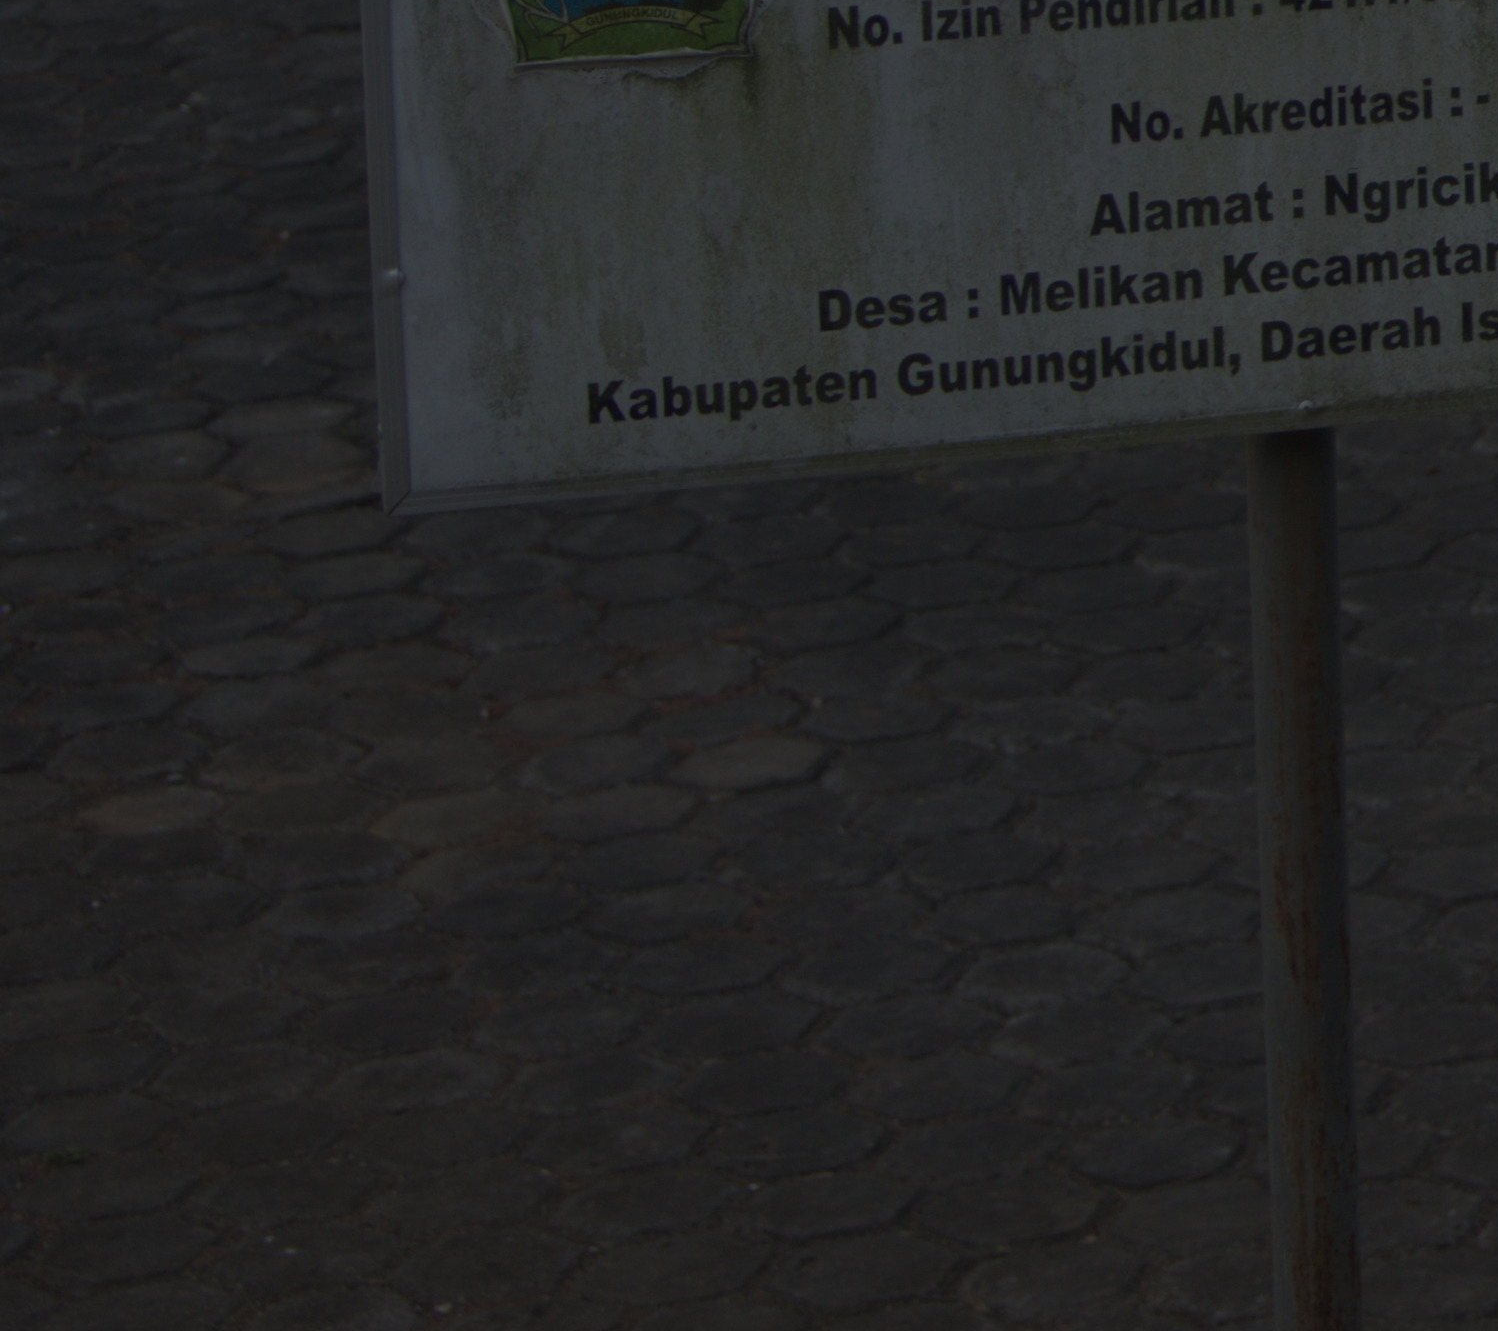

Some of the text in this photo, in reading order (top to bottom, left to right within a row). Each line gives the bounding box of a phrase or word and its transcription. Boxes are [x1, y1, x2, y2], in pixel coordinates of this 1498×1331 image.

[585, 8, 679, 26] GUNUNGKIDUL
[827, 3, 903, 50] No.
[1110, 77, 1491, 145] No. Akreditasi : -
[1089, 181, 1274, 237] Alamat
[1291, 188, 1305, 220] :
[817, 288, 948, 333] Desa
[967, 288, 980, 320] :
[999, 264, 1203, 316] Melikan
[586, 365, 877, 425] Kabupaten
[897, 325, 1241, 397] Gunungkidul,
[1260, 306, 1441, 364] Daerah
